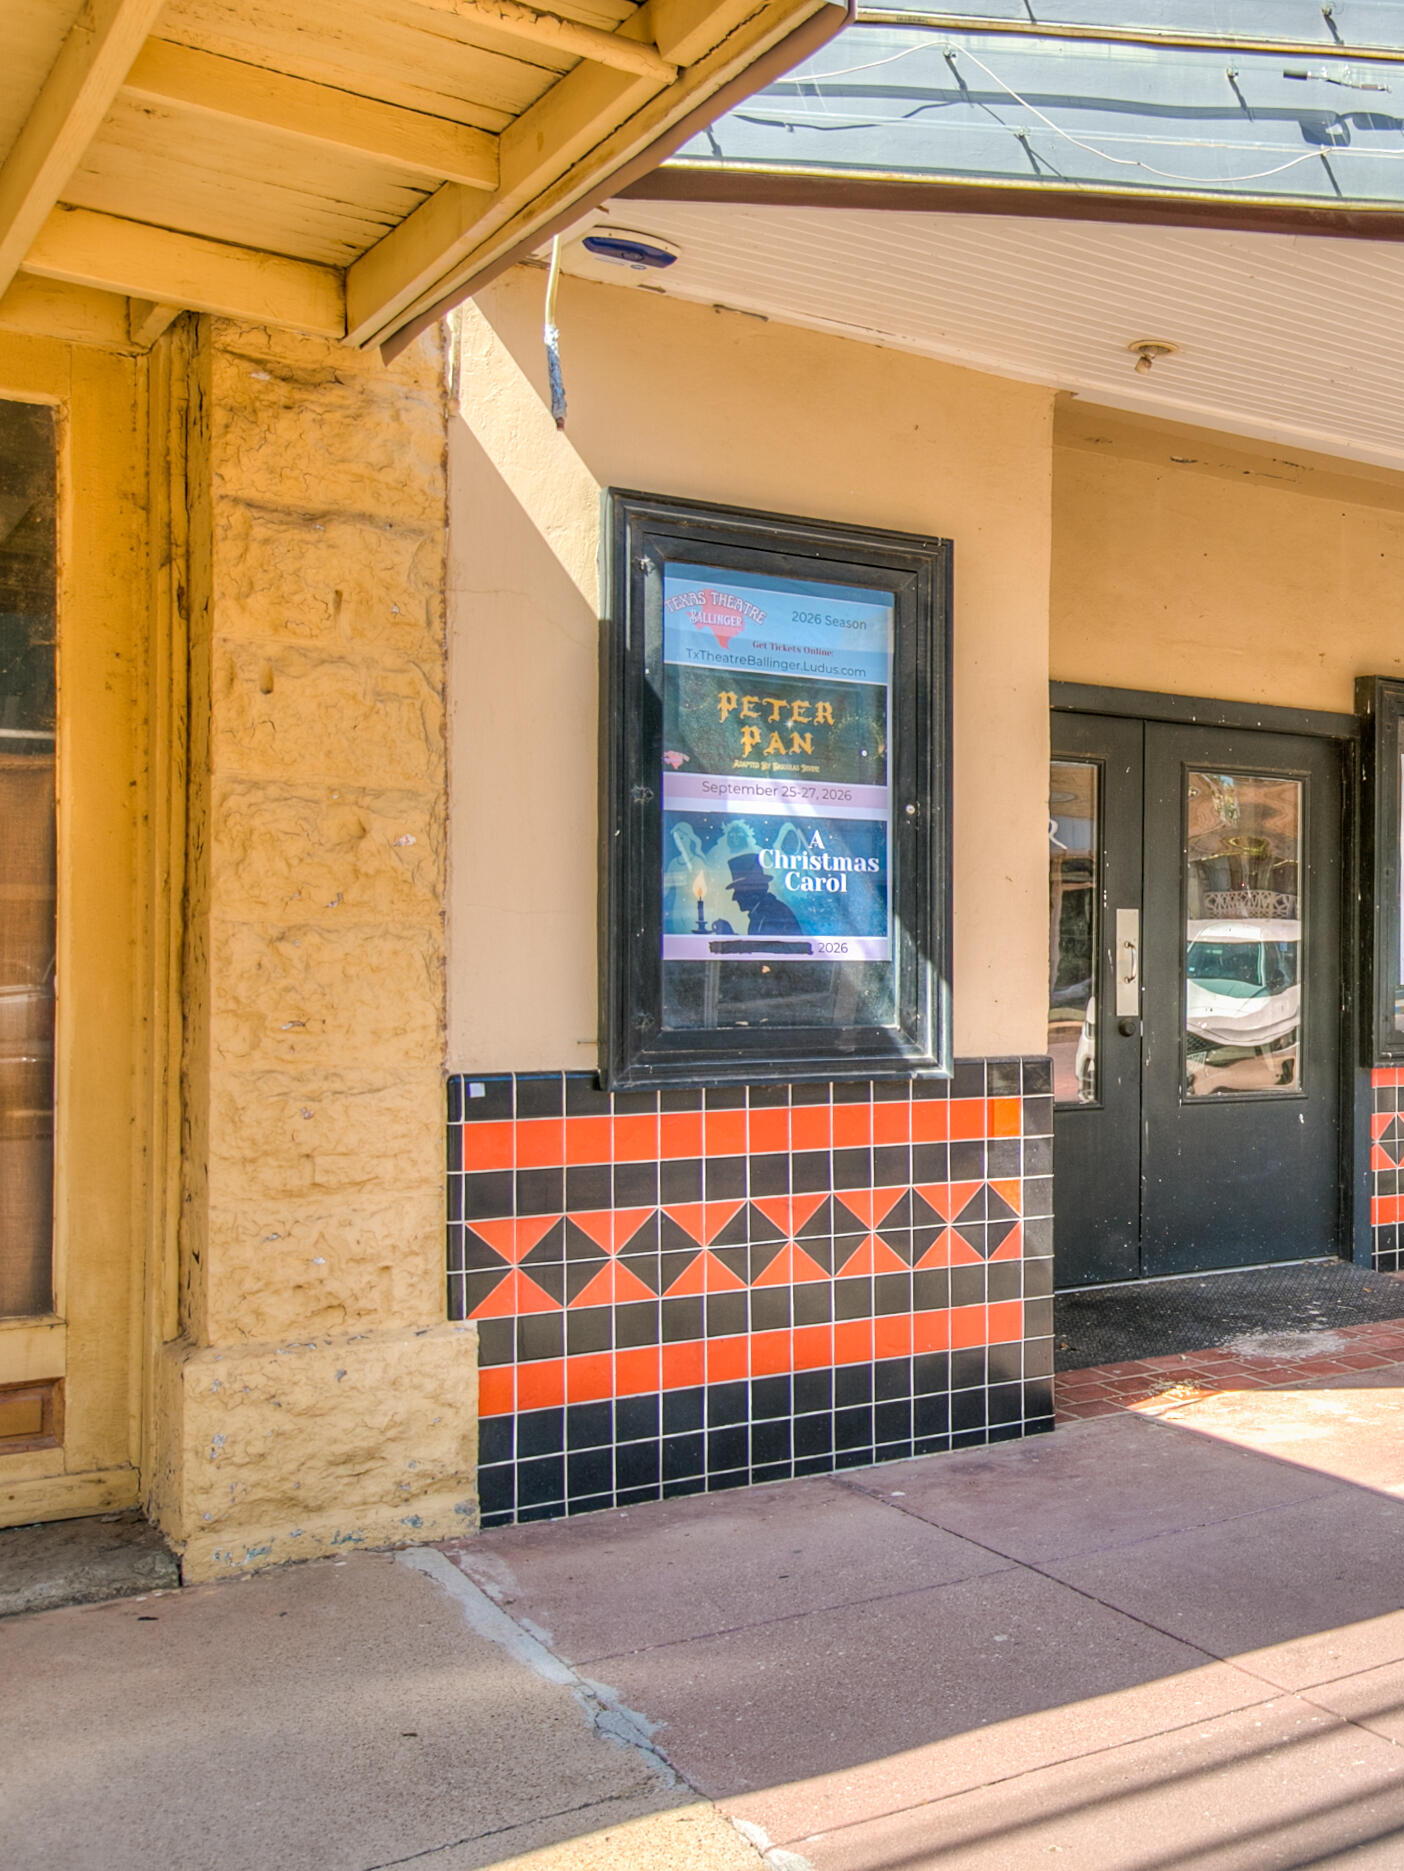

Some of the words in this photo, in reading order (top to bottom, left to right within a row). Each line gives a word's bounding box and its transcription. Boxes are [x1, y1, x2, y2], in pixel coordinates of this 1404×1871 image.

[664, 591, 707, 613] TEXAS
[710, 591, 767, 625] THEATRE
[688, 608, 744, 628] BALLINGER
[791, 611, 822, 625] 2026
[824, 614, 867, 630] Season
[752, 640, 767, 650] Get
[770, 642, 801, 653] Tickets
[686, 647, 867, 678] TxTheatreBallinger.Ludus.com
[717, 690, 835, 726] PETER
[741, 725, 815, 758] PAN
[701, 780, 778, 796] September
[781, 785, 820, 801] 25-27,
[822, 788, 853, 801] 2026
[808, 829, 825, 850] A
[758, 848, 880, 873] Christmas
[784, 871, 848, 893] Carol
[818, 942, 849, 954] 2026
